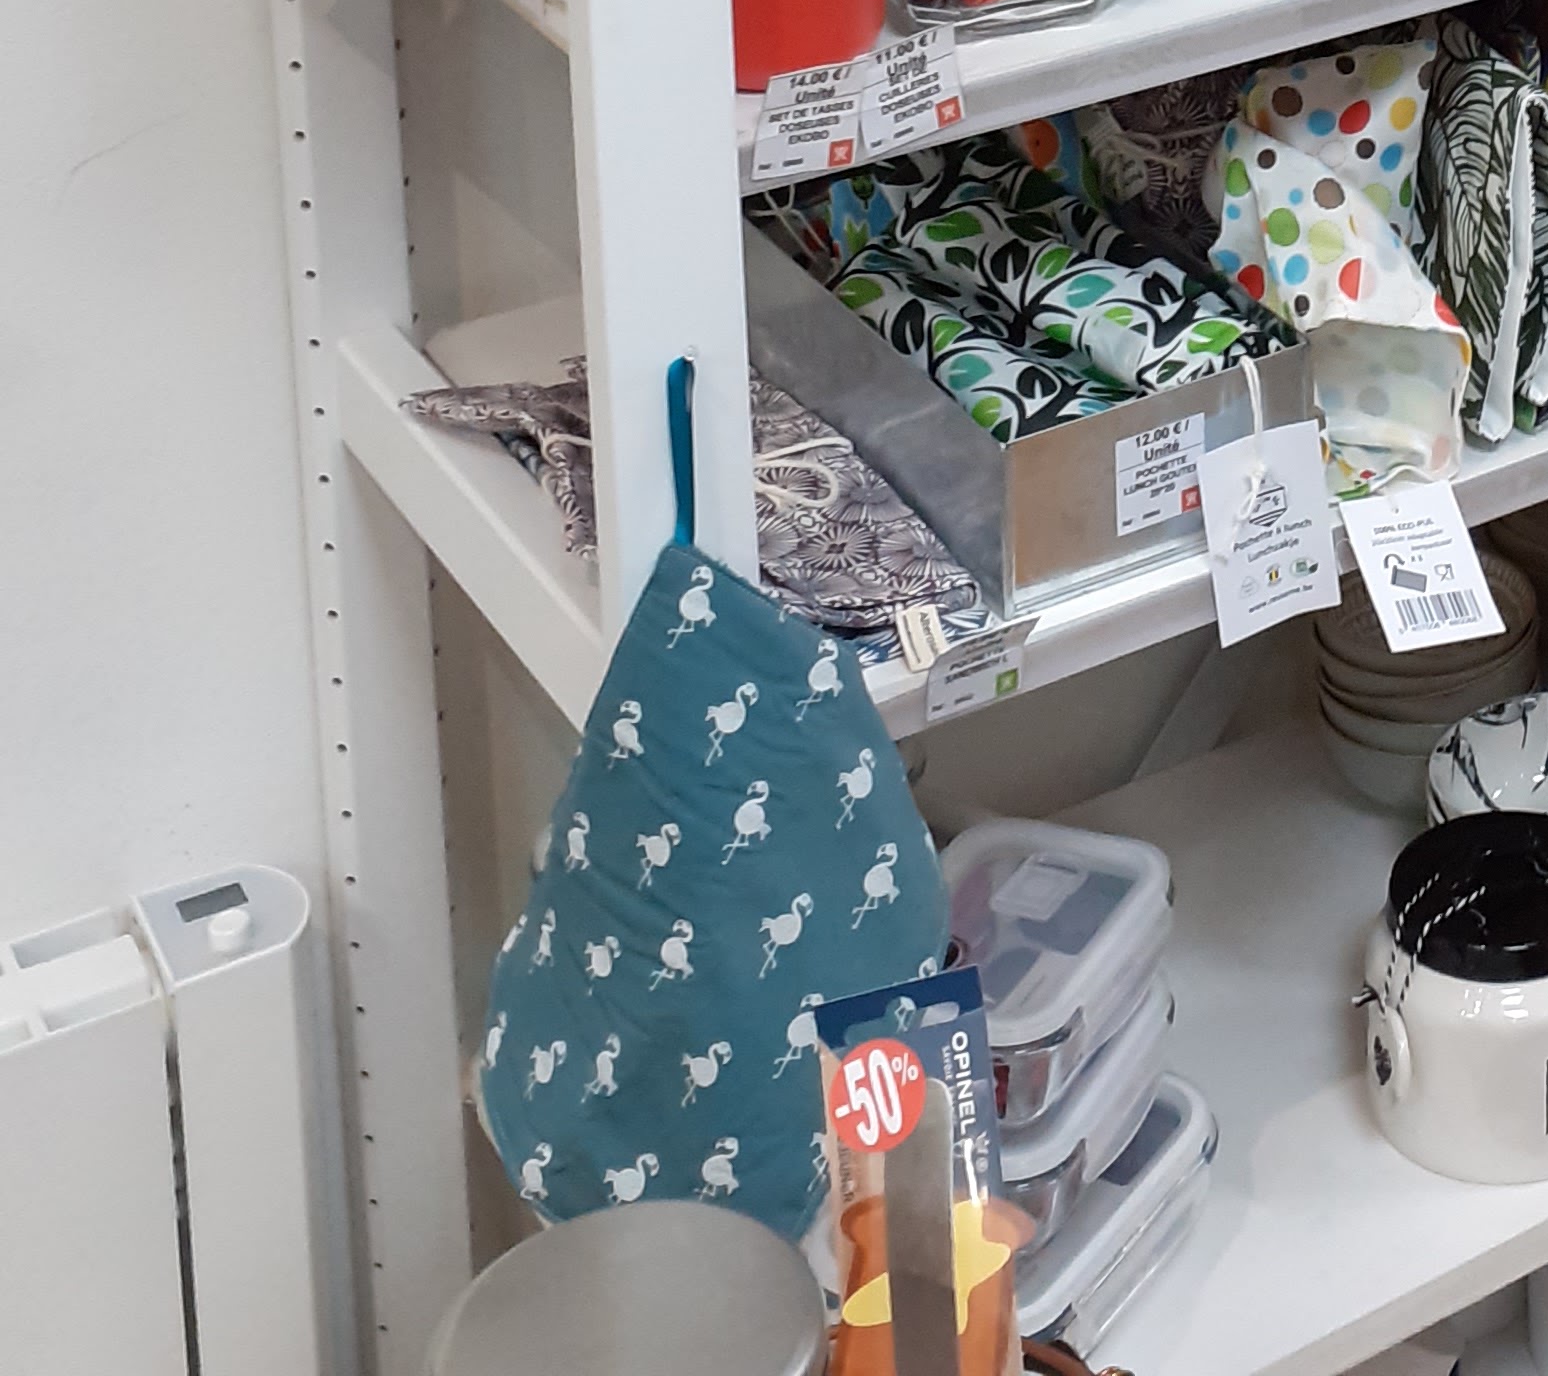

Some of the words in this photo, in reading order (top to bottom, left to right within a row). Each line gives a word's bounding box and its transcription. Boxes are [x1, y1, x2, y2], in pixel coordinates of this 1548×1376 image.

[875, 41, 915, 64] 11.00
[886, 52, 927, 78] Unité
[789, 71, 829, 89] 14.00
[795, 86, 835, 105] Unité
[768, 110, 790, 123] SET
[792, 107, 810, 119] DE
[894, 100, 933, 123] EKOBO
[788, 130, 830, 144] EKOBO
[1135, 426, 1170, 448] 12.00
[1144, 439, 1180, 461] Unité
[1135, 455, 1188, 480] POCHETTE
[1123, 477, 1157, 496] LUNCH
[1233, 528, 1273, 552] Pochette
[1284, 519, 1312, 532] lunch
[951, 1031, 976, 1136] OPINEL
[835, 1049, 919, 1146] -50%
